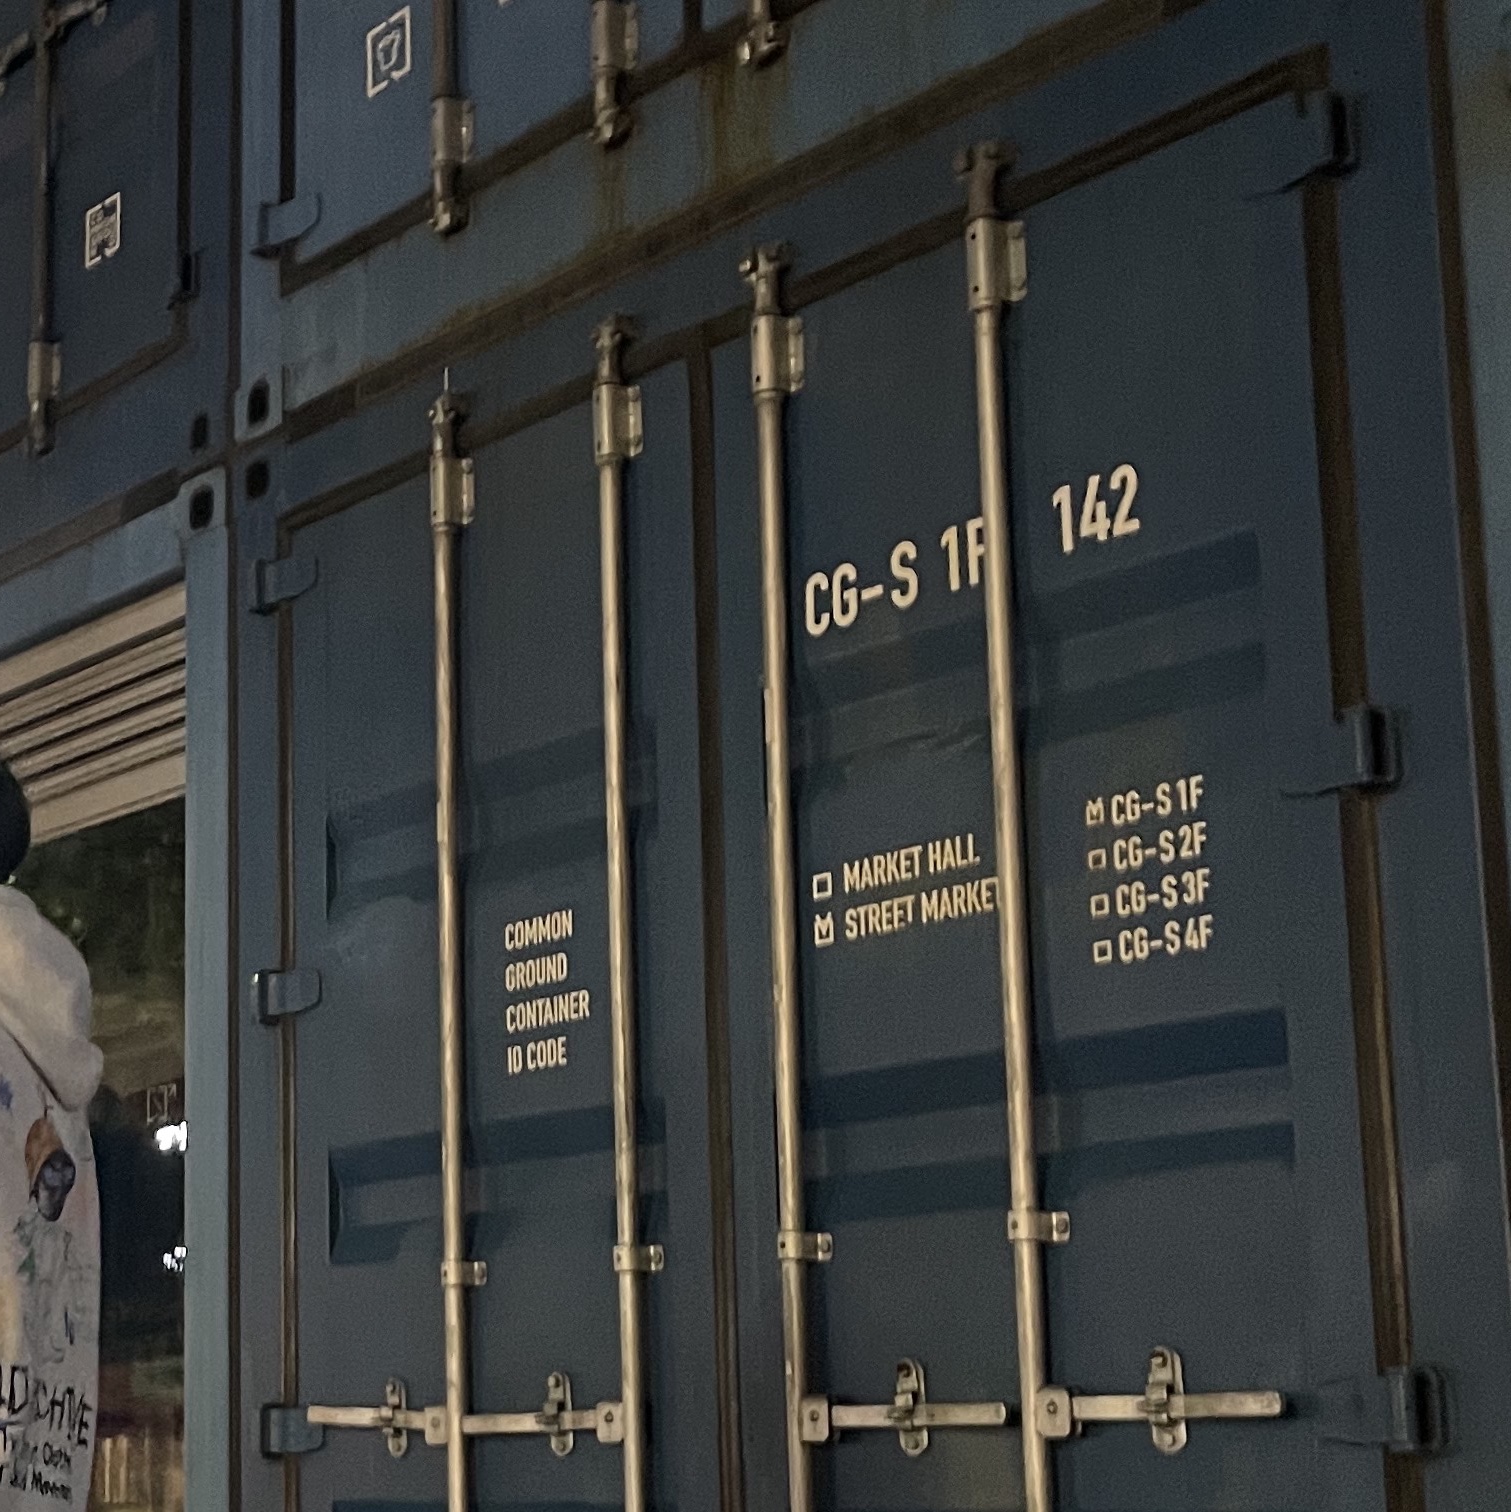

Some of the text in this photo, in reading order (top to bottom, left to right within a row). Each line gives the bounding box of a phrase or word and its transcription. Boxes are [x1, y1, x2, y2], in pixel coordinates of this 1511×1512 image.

[805, 539, 919, 637] CG-S
[1052, 463, 1140, 554] 142
[843, 832, 980, 894] MARKET HALL
[505, 909, 573, 951] COMMON
[845, 894, 915, 940] STREET
[505, 952, 568, 992] GROUND
[506, 989, 590, 1034] CONTAINER
[507, 1036, 567, 1076] ID CODE
